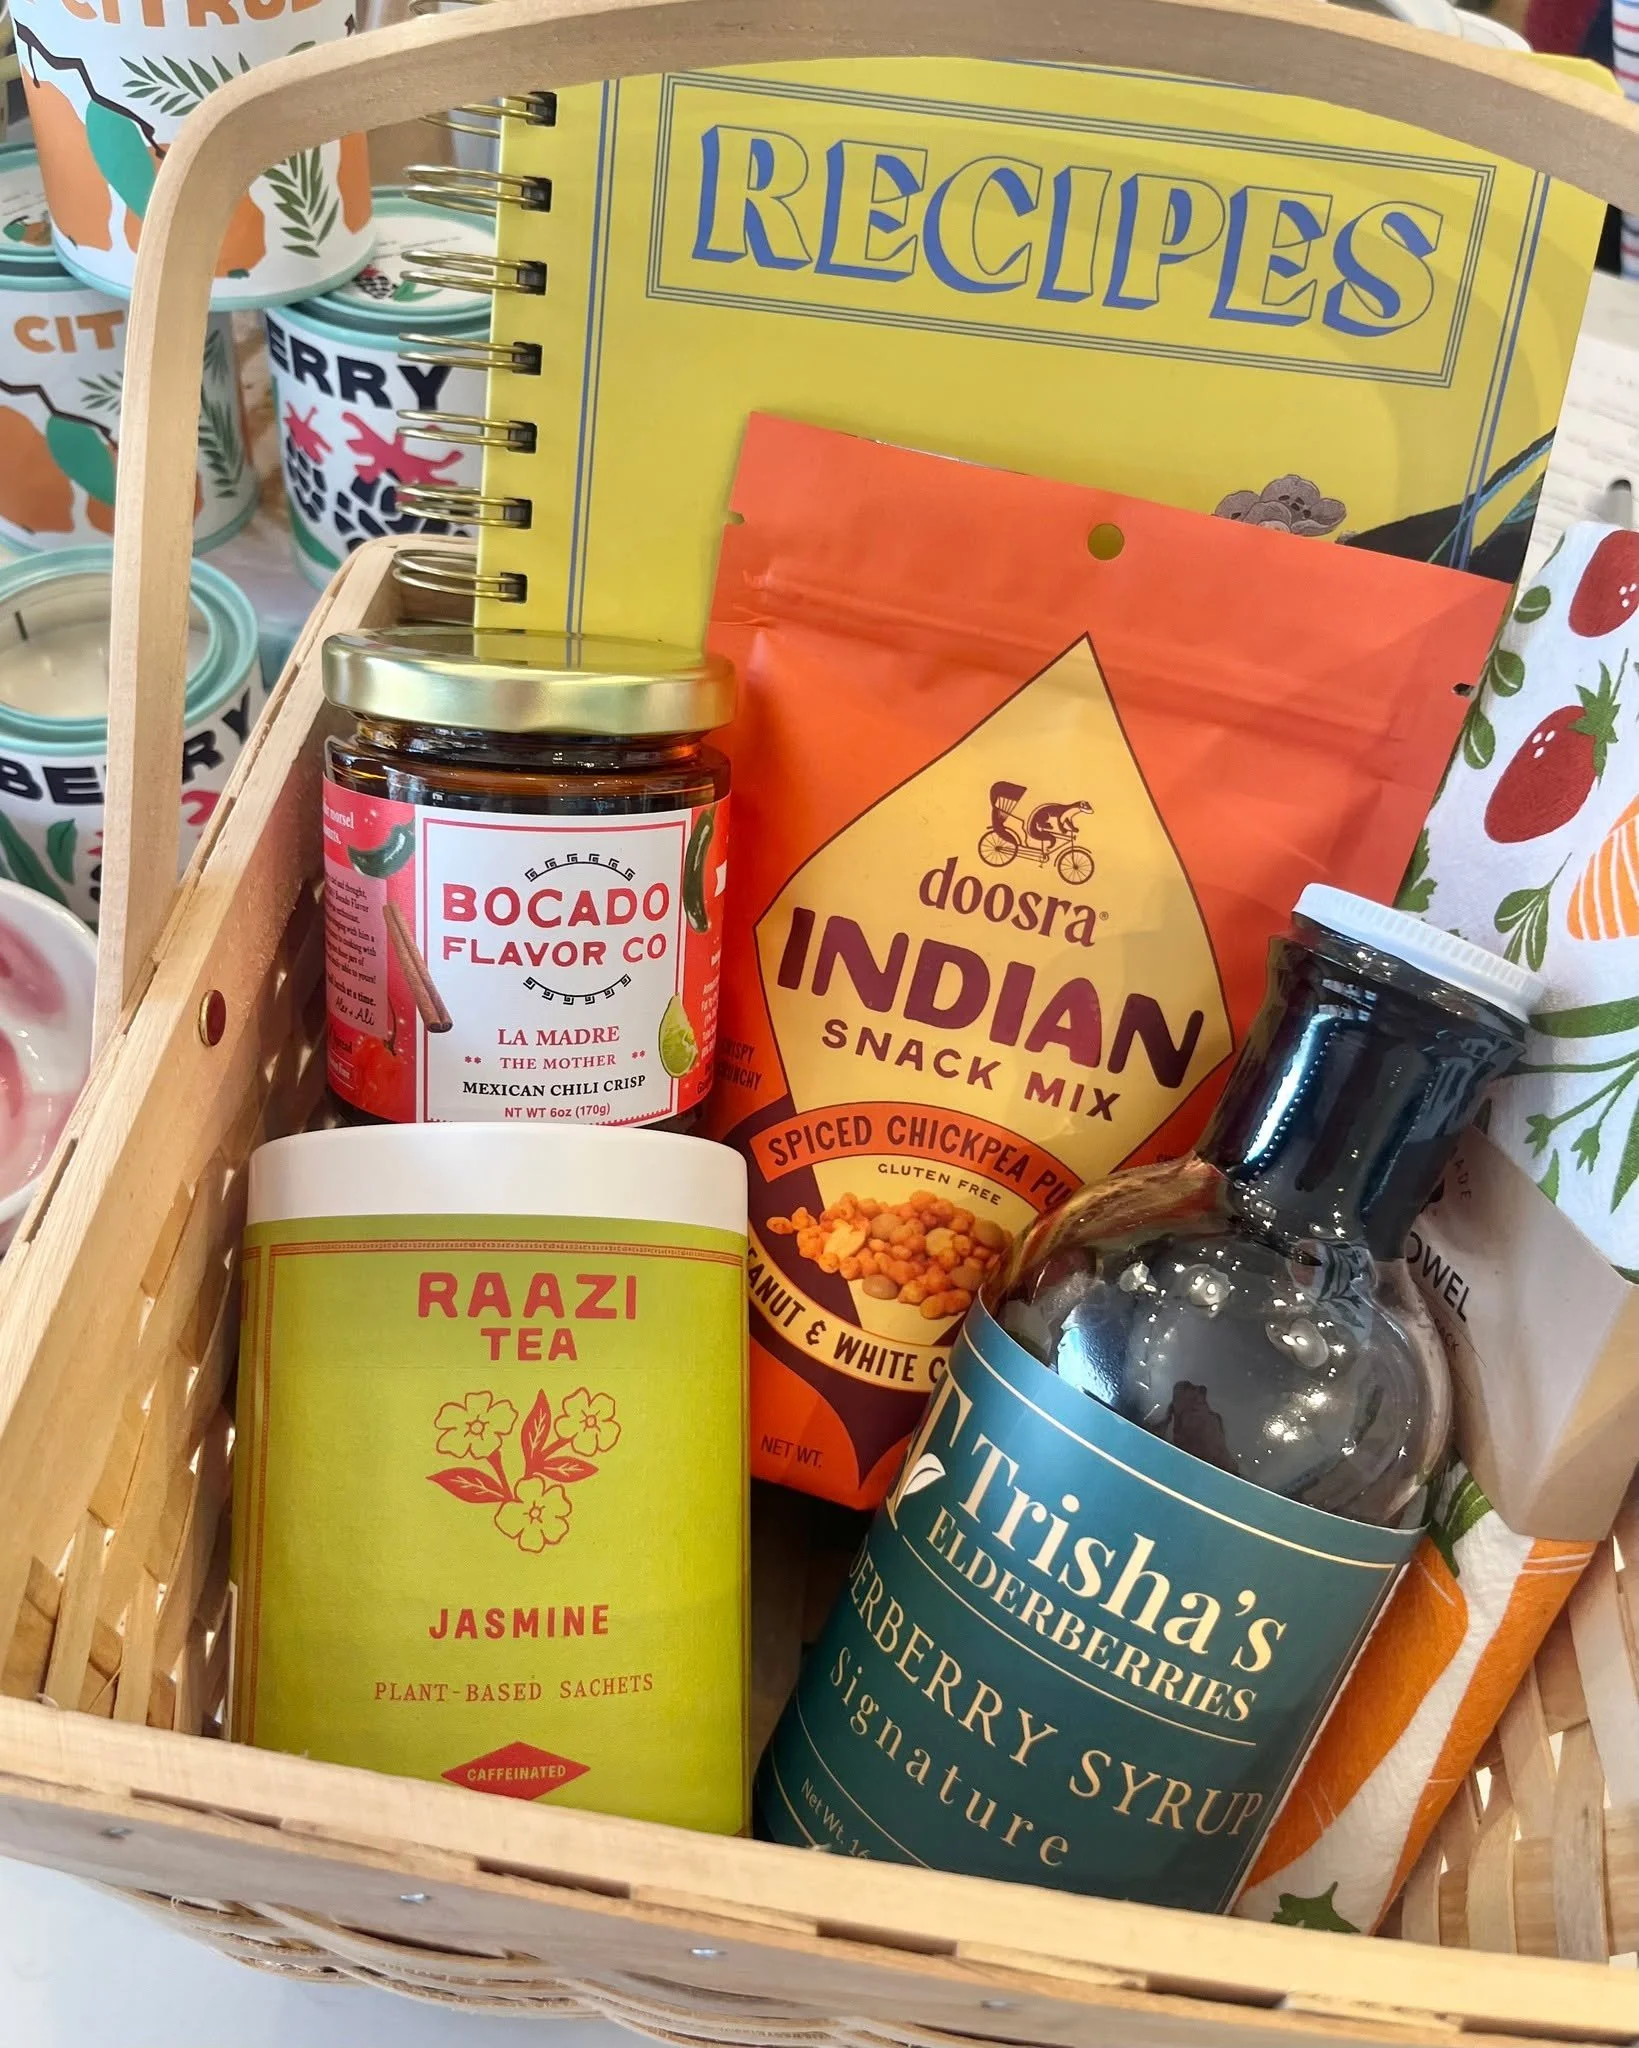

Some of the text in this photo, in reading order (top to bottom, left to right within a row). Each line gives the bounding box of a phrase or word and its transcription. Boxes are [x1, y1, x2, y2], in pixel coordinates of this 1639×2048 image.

[692, 125, 1444, 338] RECIPES
[0, 687, 250, 806] BERY
[443, 882, 670, 929] BOCADO
[443, 932, 667, 967] FLAVOR CO
[777, 907, 1204, 1088] INDIAN
[498, 1025, 619, 1047] LA MADRE
[500, 1054, 616, 1070] THE MOTHER
[822, 1018, 1121, 1121] SNACK MIX
[462, 1075, 646, 1097] MEXICAN CHILI CRISP
[505, 1102, 611, 1118] NT WT 6oz (170g)
[768, 1115, 872, 1167] SPICED
[887, 1115, 1030, 1187] CHICKPEA
[878, 1162, 1002, 1206] GLUTEN FREE
[417, 1271, 638, 1321] RAAZI
[480, 1327, 578, 1362] TEA
[805, 1320, 828, 1345] &
[833, 1331, 918, 1383] WHITE
[761, 1435, 823, 1468] NET WT.
[428, 1603, 610, 1641] JASMINE
[926, 1507, 1258, 1723] ELDERBERRIES
[374, 1673, 654, 1703] PLANT-BASED SACHETS
[466, 1763, 567, 1782] CAFFEINATED
[830, 1645, 1070, 1868] Signature
[801, 1778, 822, 1816] Net
[823, 1805, 844, 1844] Wt.
[1068, 1748, 1263, 1838] SYRUP
